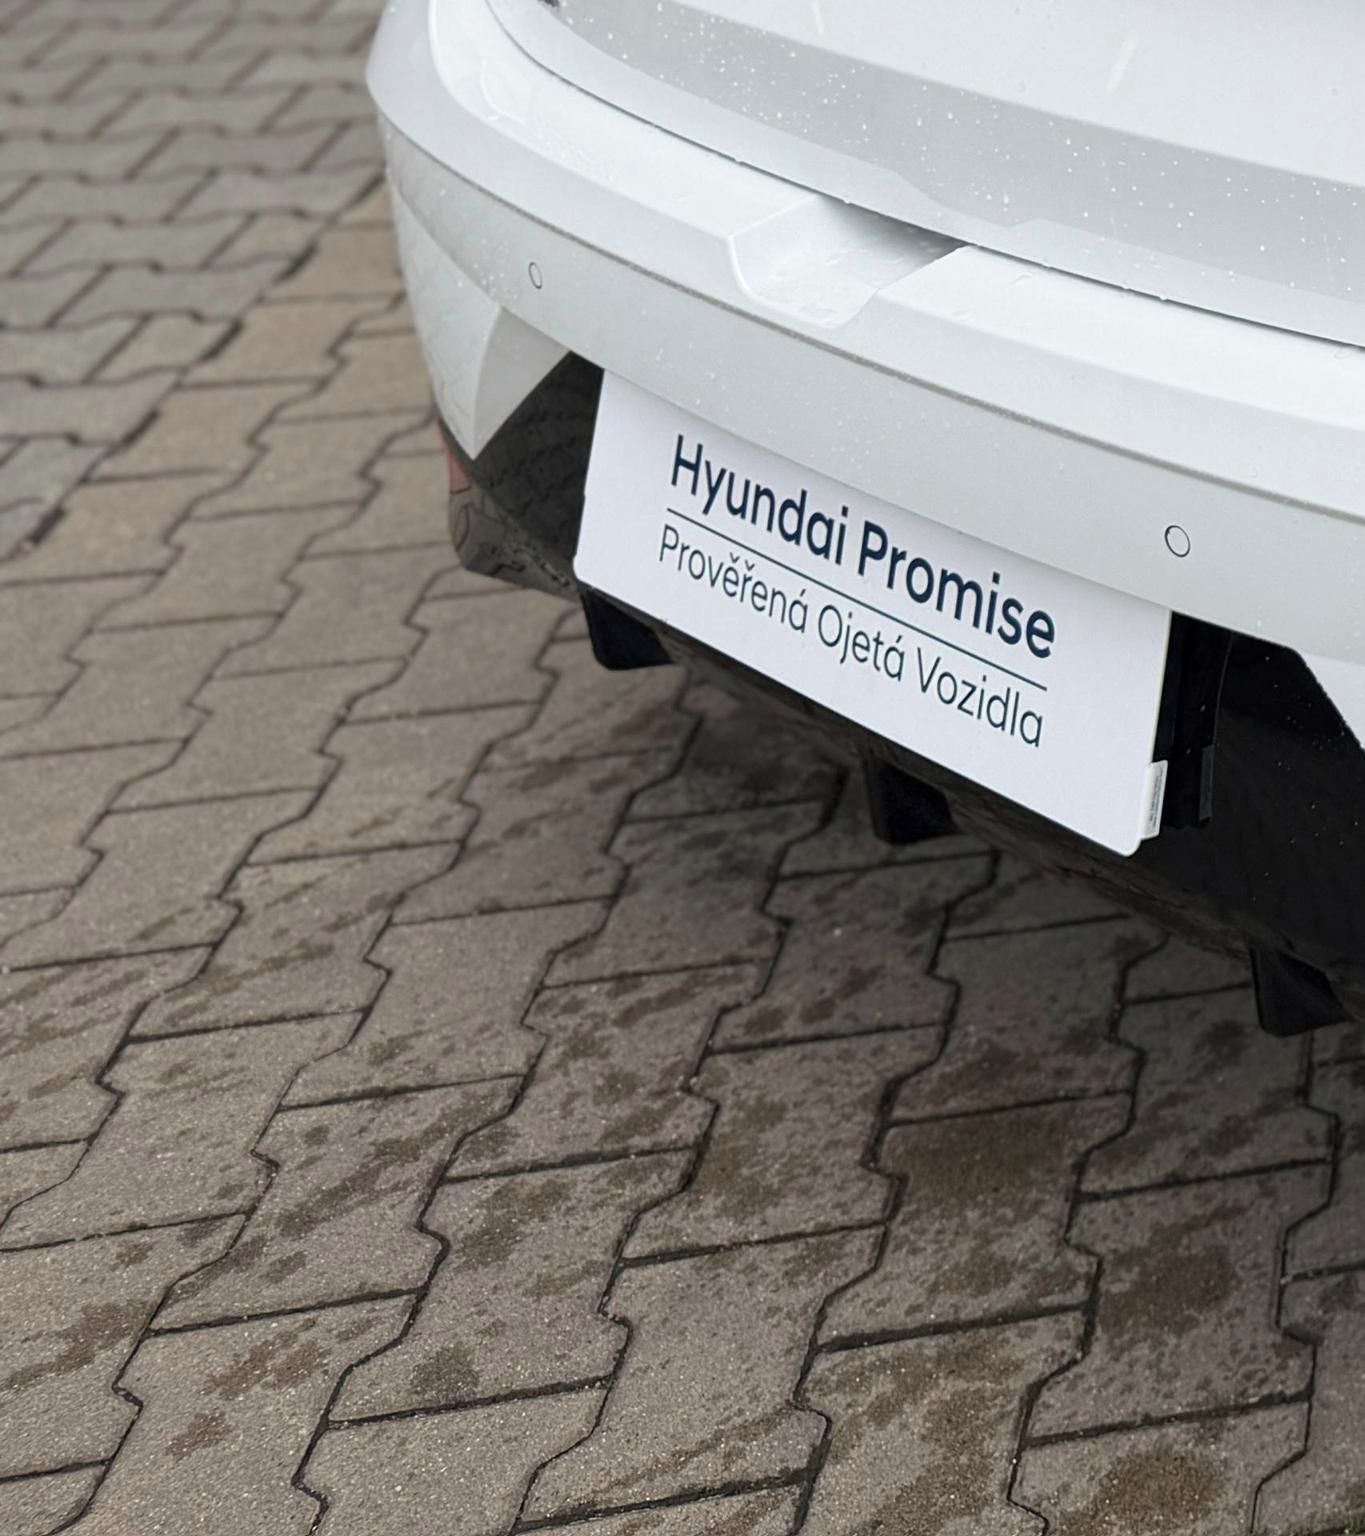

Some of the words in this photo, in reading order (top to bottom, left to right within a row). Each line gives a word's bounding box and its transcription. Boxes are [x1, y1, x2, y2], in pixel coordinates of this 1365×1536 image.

[659, 523, 808, 634] Prověřená
[817, 604, 905, 682] Ojetá
[917, 647, 1043, 748] Vozidla
[671, 433, 849, 566] Hyundai
[857, 519, 1055, 659] Promise
